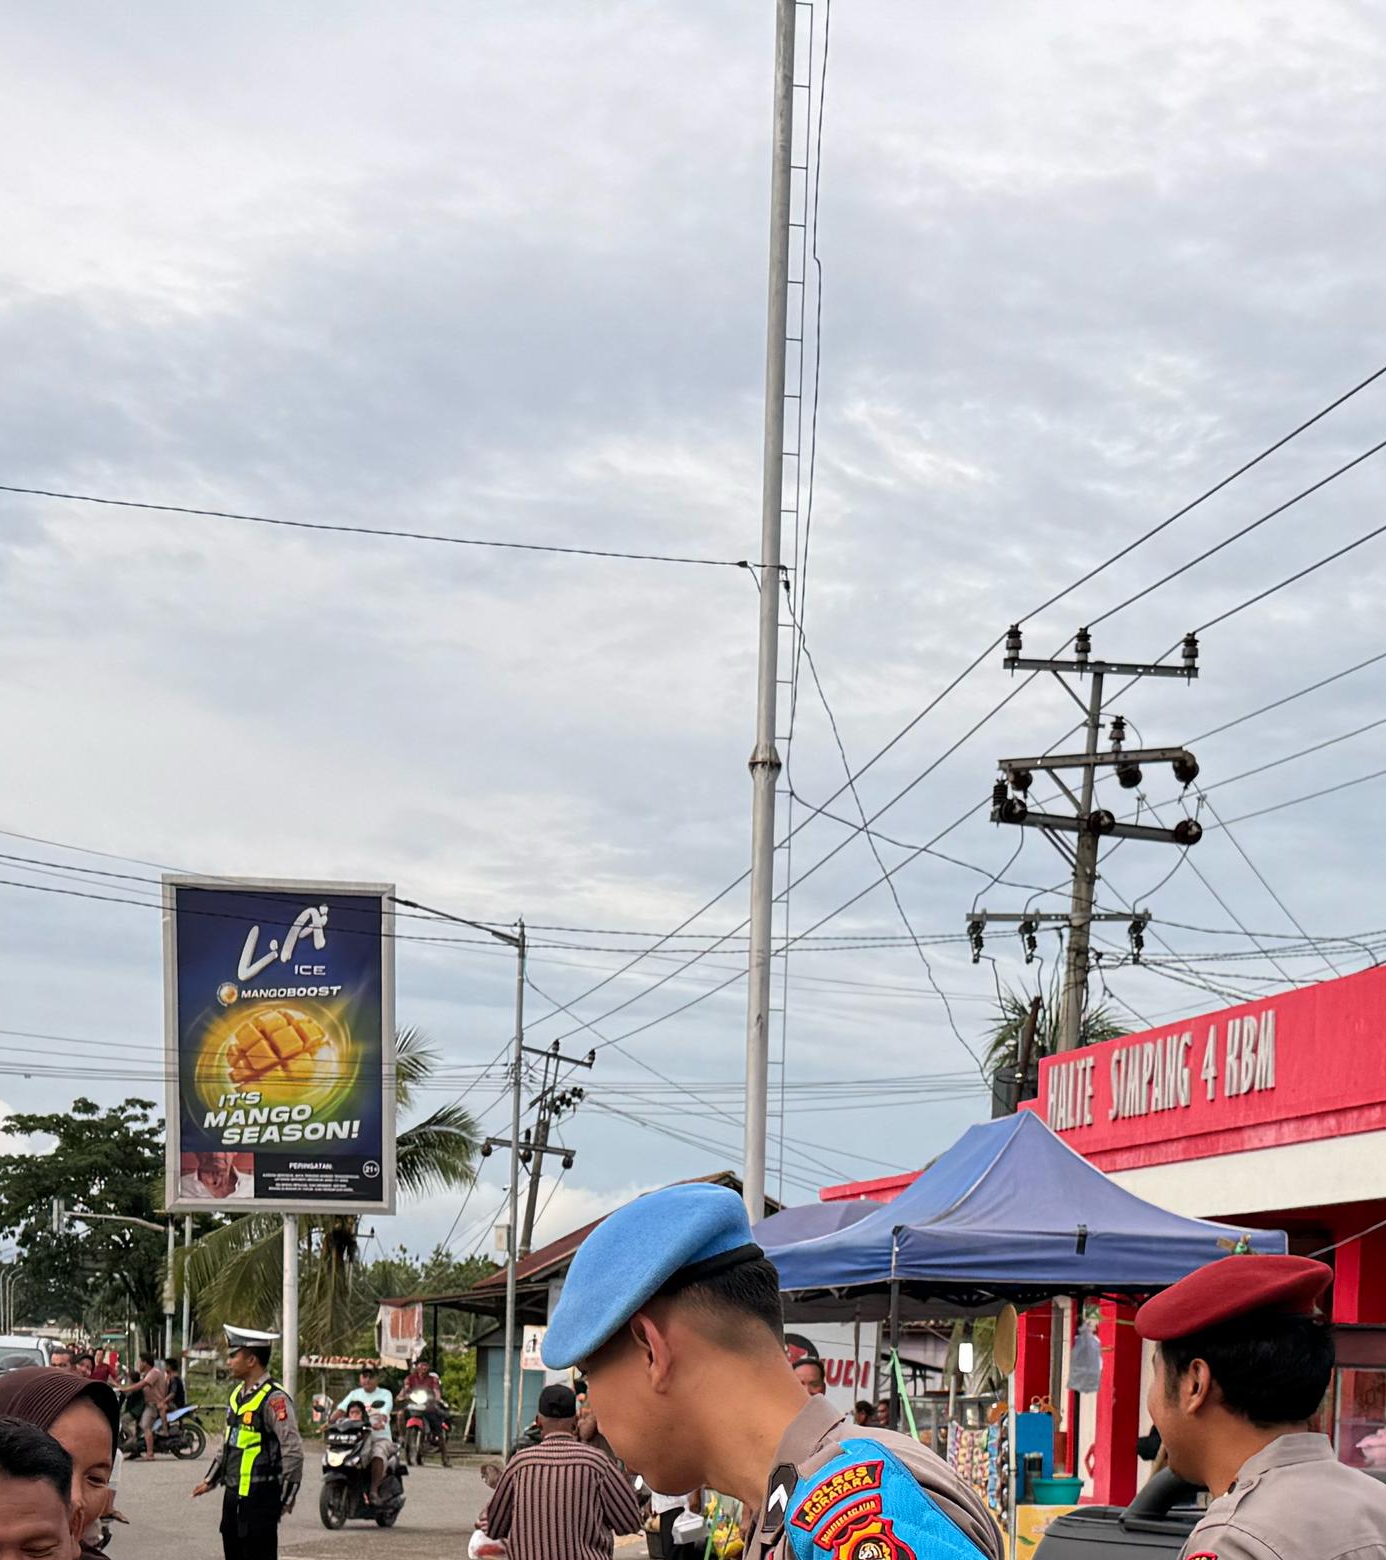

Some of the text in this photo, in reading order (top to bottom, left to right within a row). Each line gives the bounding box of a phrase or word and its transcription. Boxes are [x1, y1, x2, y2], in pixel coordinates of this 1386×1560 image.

[294, 964, 326, 976] ICE
[241, 986, 341, 999] MANGOBOOST
[1109, 1032, 1193, 1121] SIMPANG
[1201, 1024, 1218, 1101] 4
[1224, 1008, 1276, 1098] KBM
[218, 1091, 262, 1107] IT'S
[203, 1104, 312, 1129] MANGO
[221, 1120, 361, 1145] SEASON!
[804, 1466, 869, 1512] POLRES
[805, 1475, 873, 1523] MURATARA
